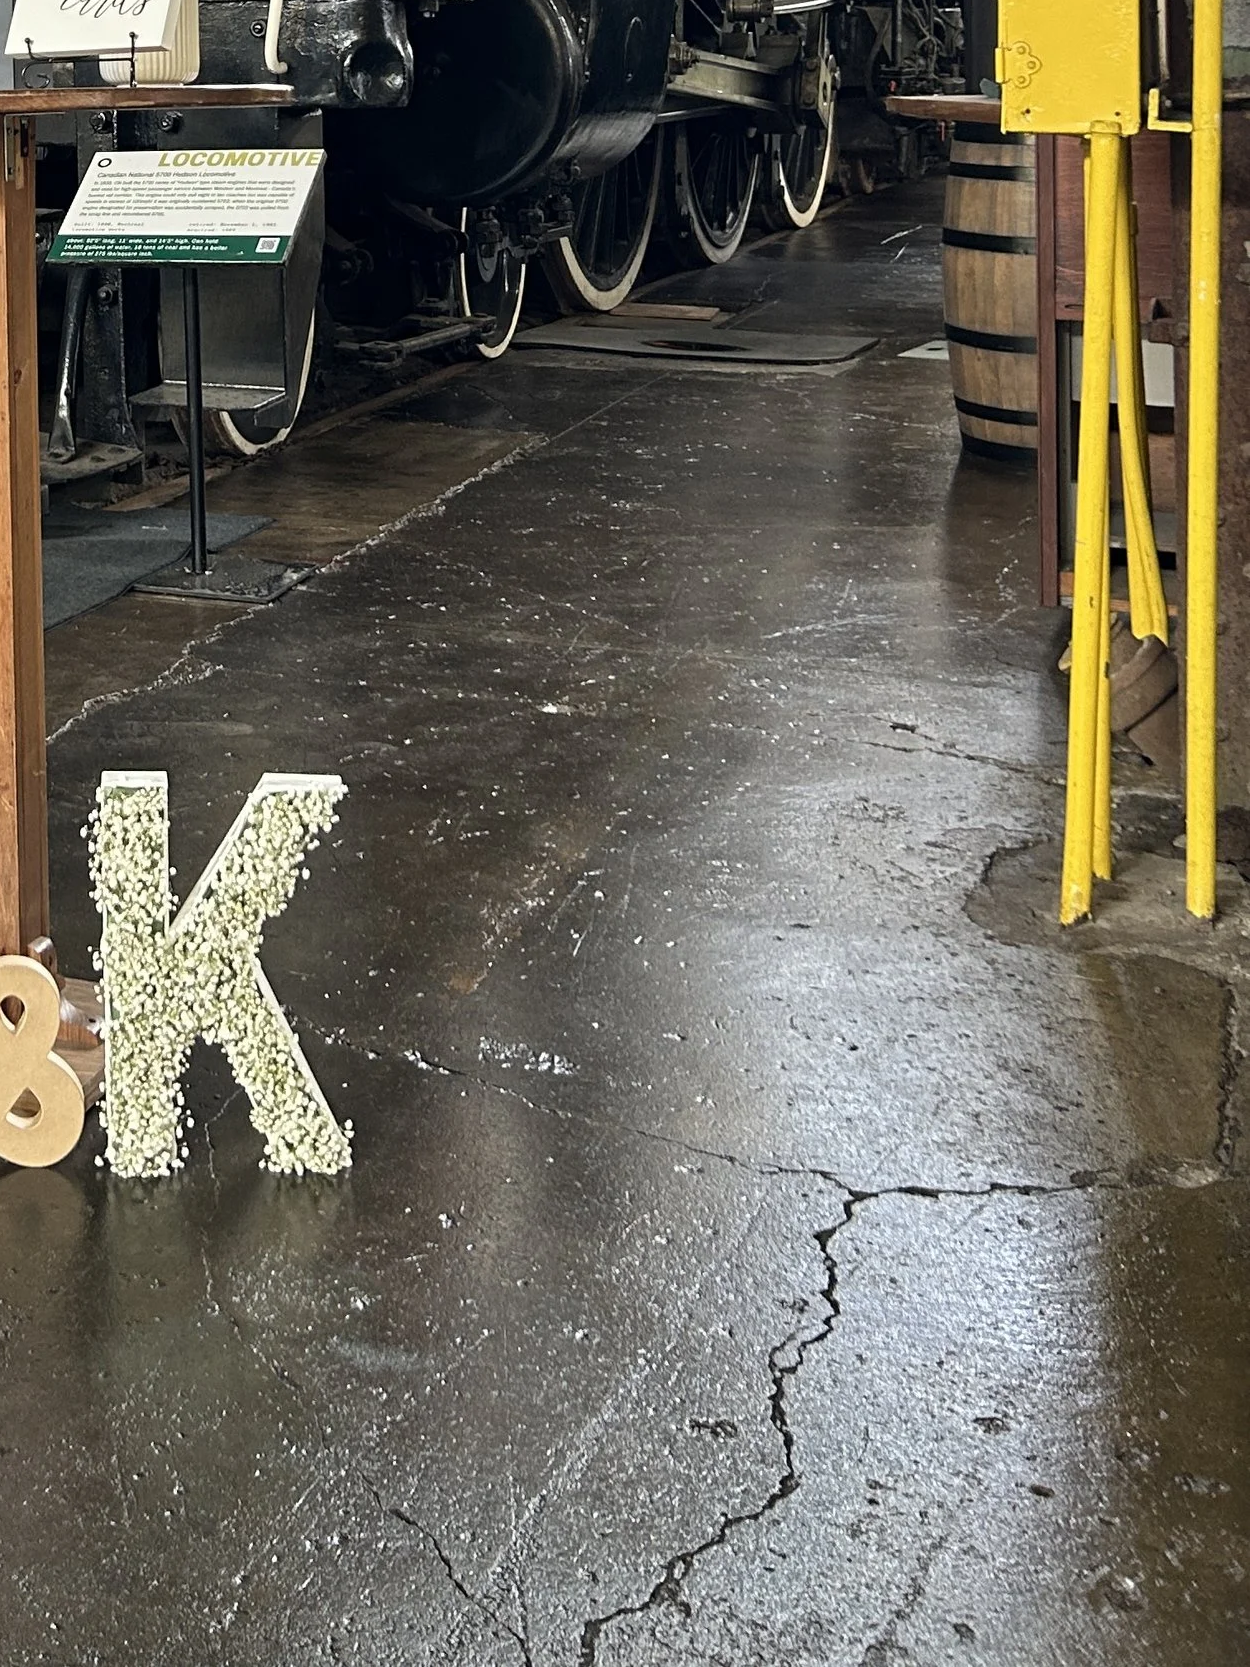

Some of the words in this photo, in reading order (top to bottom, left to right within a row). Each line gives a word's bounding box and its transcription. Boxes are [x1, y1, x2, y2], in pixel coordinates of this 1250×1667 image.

[158, 151, 322, 167] LOCOMOTIVE
[97, 171, 128, 179] Canadian
[86, 771, 354, 1177] K
